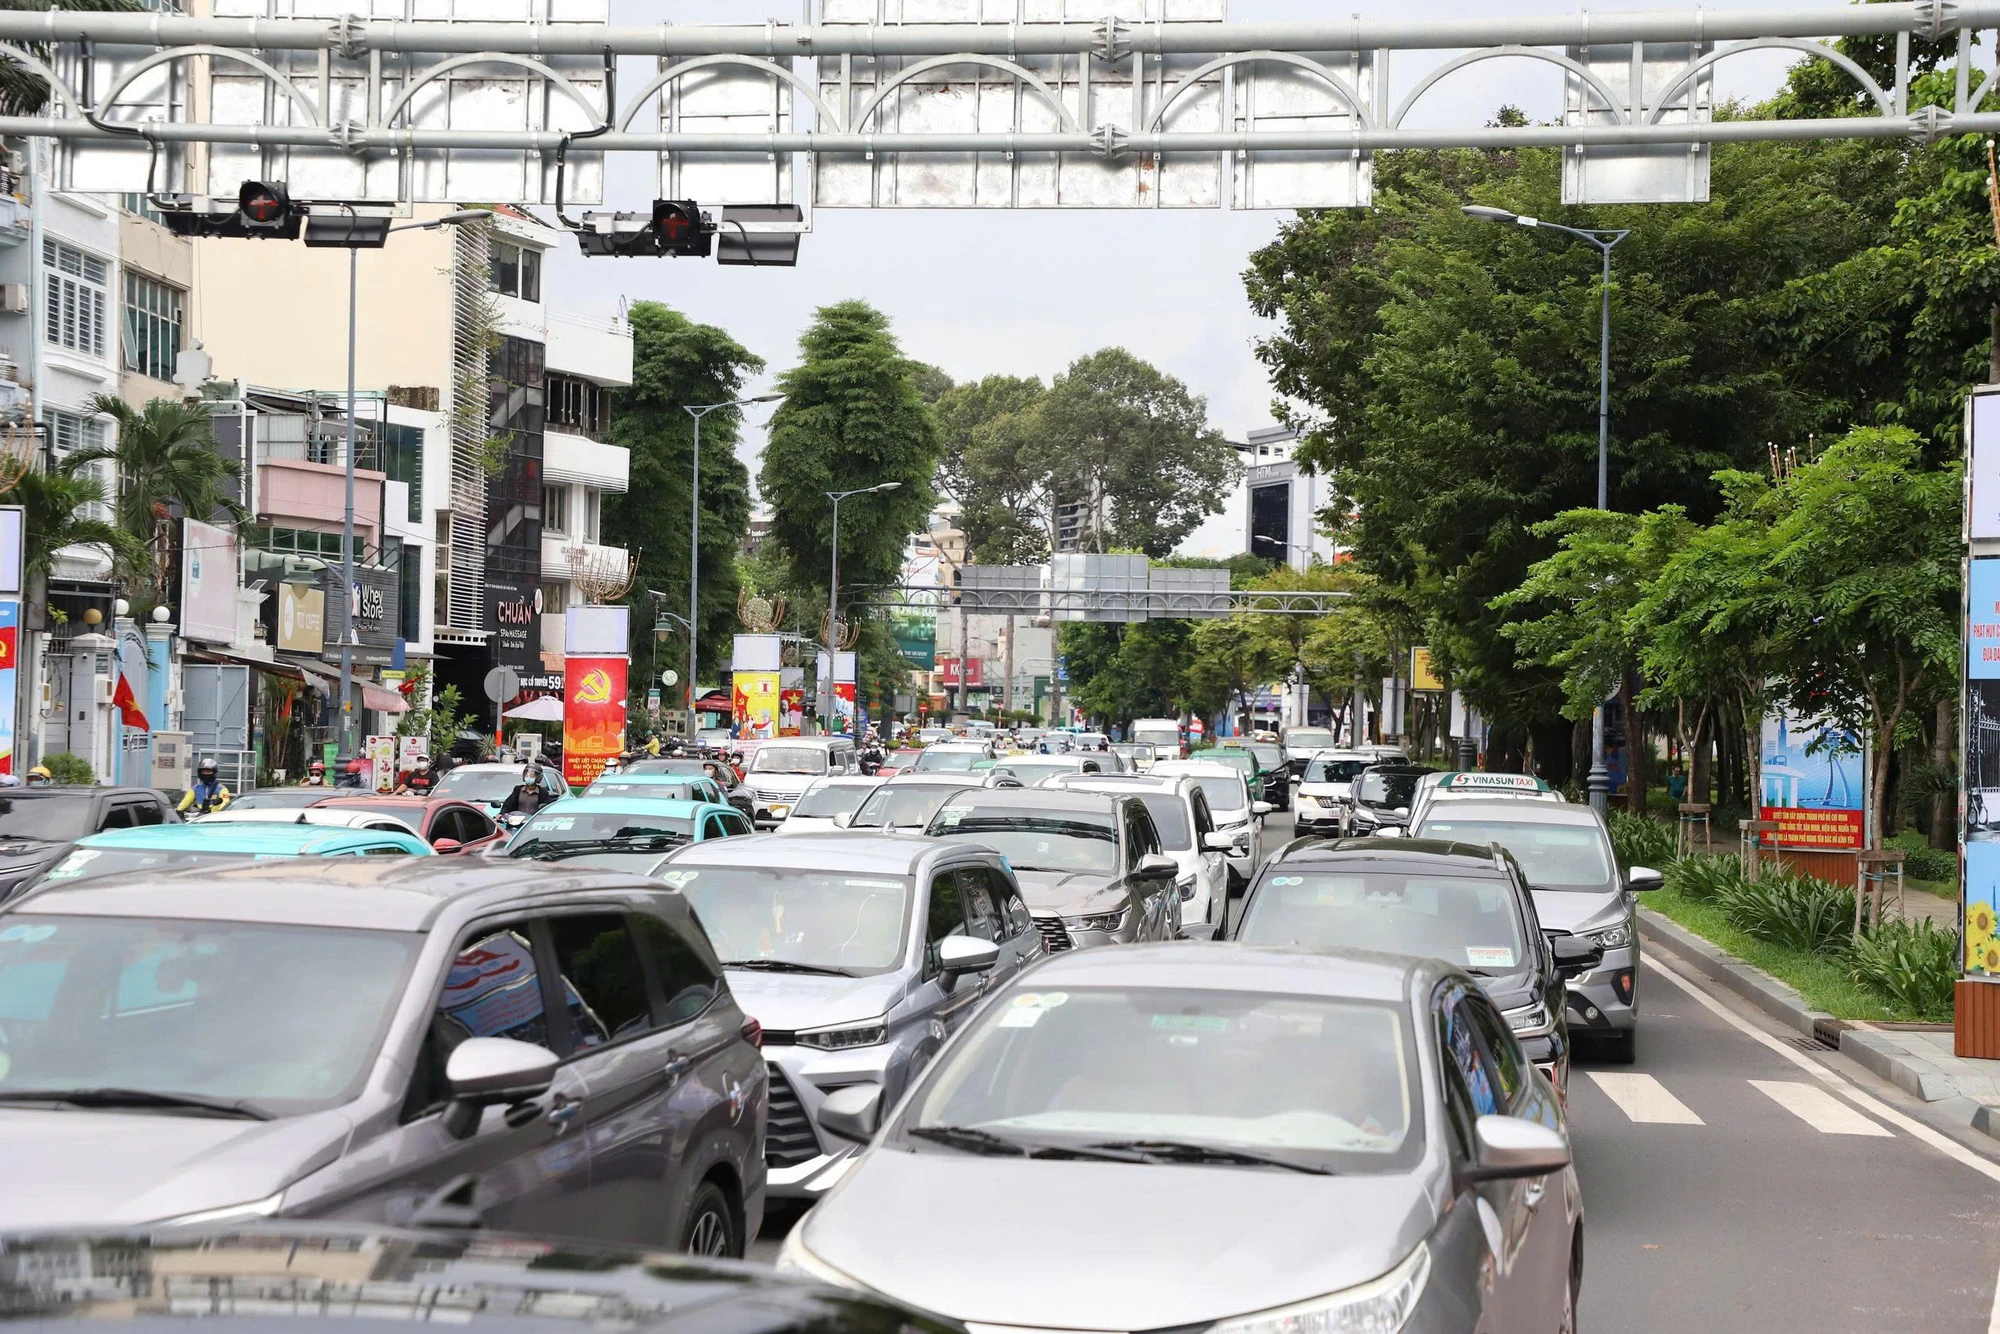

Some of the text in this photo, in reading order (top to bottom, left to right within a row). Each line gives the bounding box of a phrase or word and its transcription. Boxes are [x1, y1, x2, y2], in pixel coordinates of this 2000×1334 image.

[362, 584, 384, 604] Whey
[362, 600, 383, 619] Store
[498, 596, 532, 624] CHUẨN
[1472, 776, 1534, 786] VINASUN TAXI
